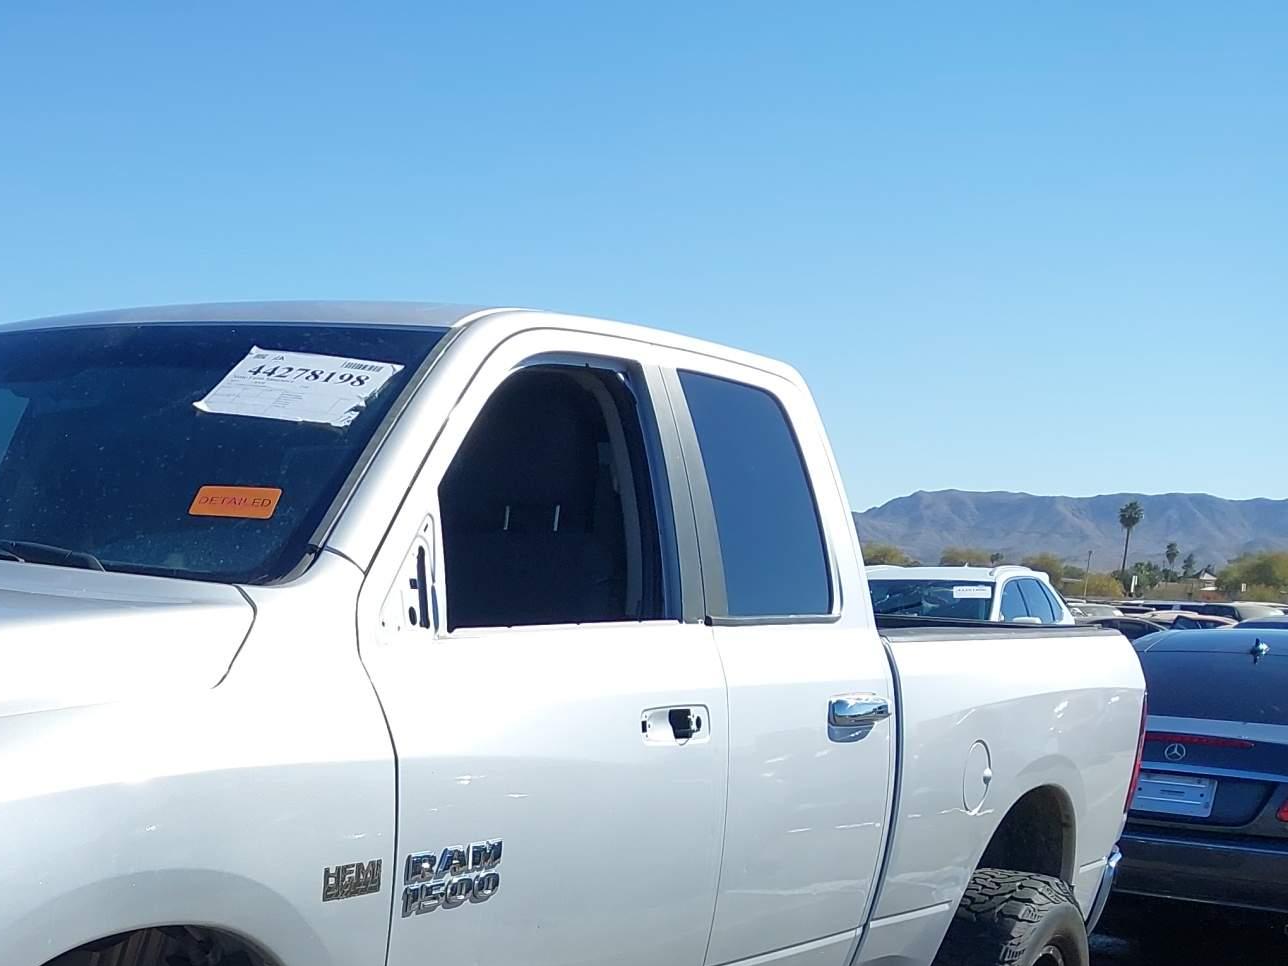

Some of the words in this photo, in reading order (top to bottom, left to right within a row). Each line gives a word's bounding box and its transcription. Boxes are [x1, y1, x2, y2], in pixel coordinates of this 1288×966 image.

[248, 364, 370, 388] 44278198
[198, 496, 272, 509] DETAILED
[323, 859, 382, 891] HEMI
[404, 838, 502, 886] RAM
[402, 870, 500, 918] 1500
